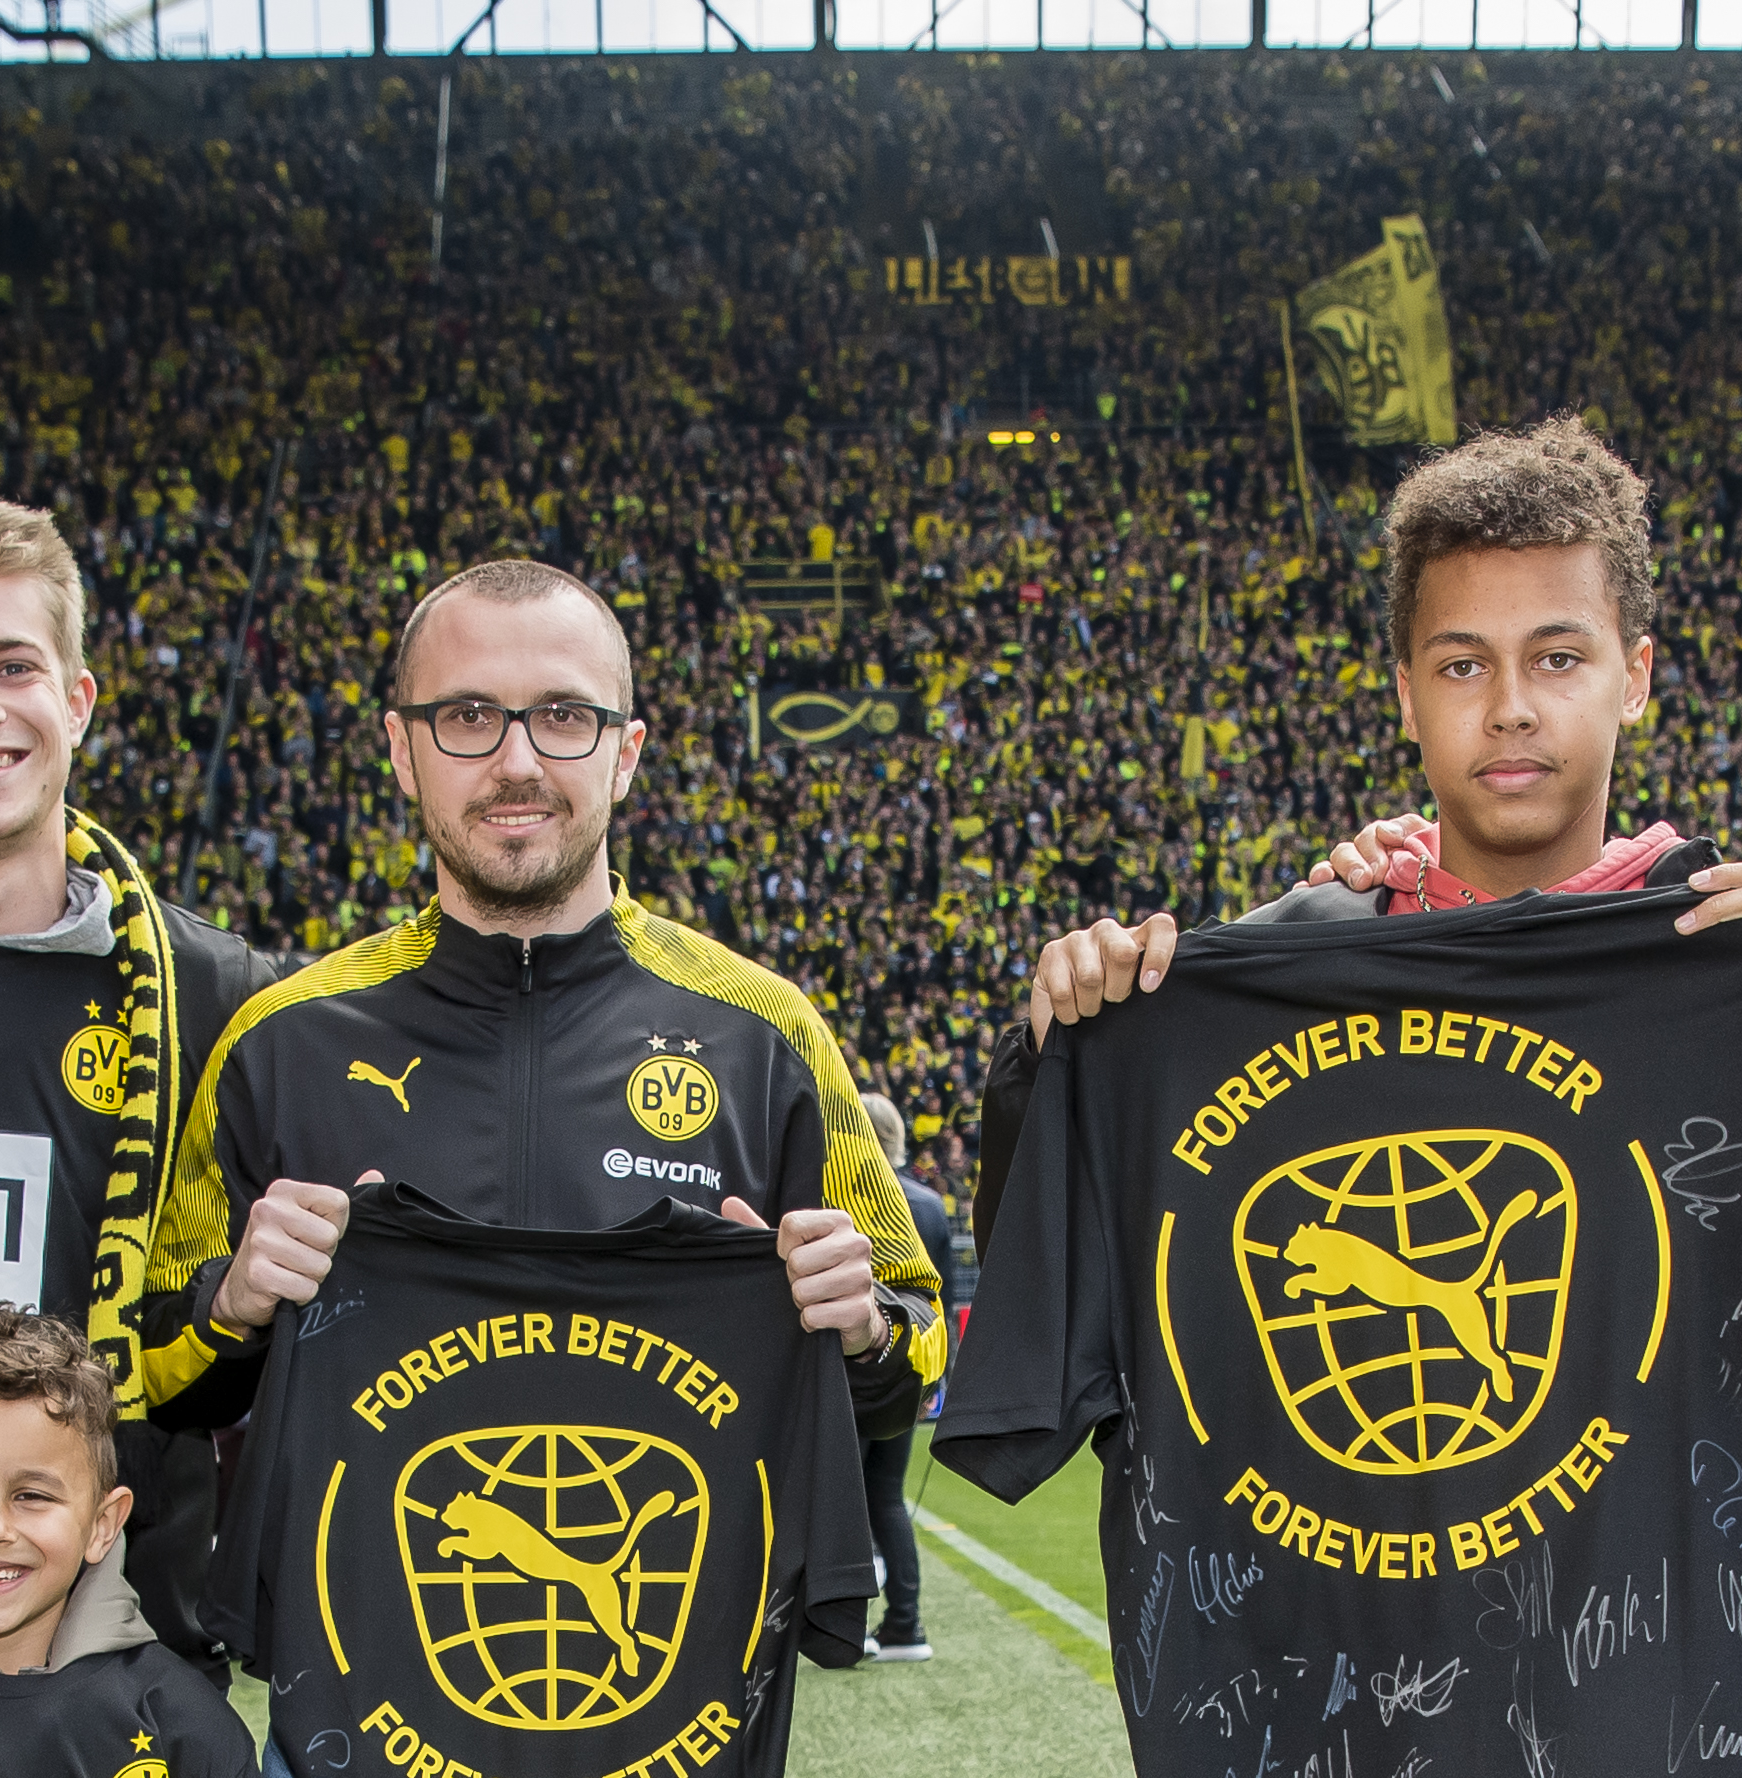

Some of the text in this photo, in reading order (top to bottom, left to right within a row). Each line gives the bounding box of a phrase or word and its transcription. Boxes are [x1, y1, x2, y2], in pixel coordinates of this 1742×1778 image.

[93, 1084, 115, 1104] 09
[642, 1065, 706, 1115] BVB
[1172, 1009, 1603, 1175] FOREVER BETTER
[659, 1112, 683, 1131] 09
[634, 1156, 722, 1191] EVONIK
[351, 1312, 556, 1432] FOREVER
[566, 1313, 740, 1429] BETTER
[1223, 1466, 1438, 1580] FOREVER
[1447, 1416, 1629, 1571] BETTER
